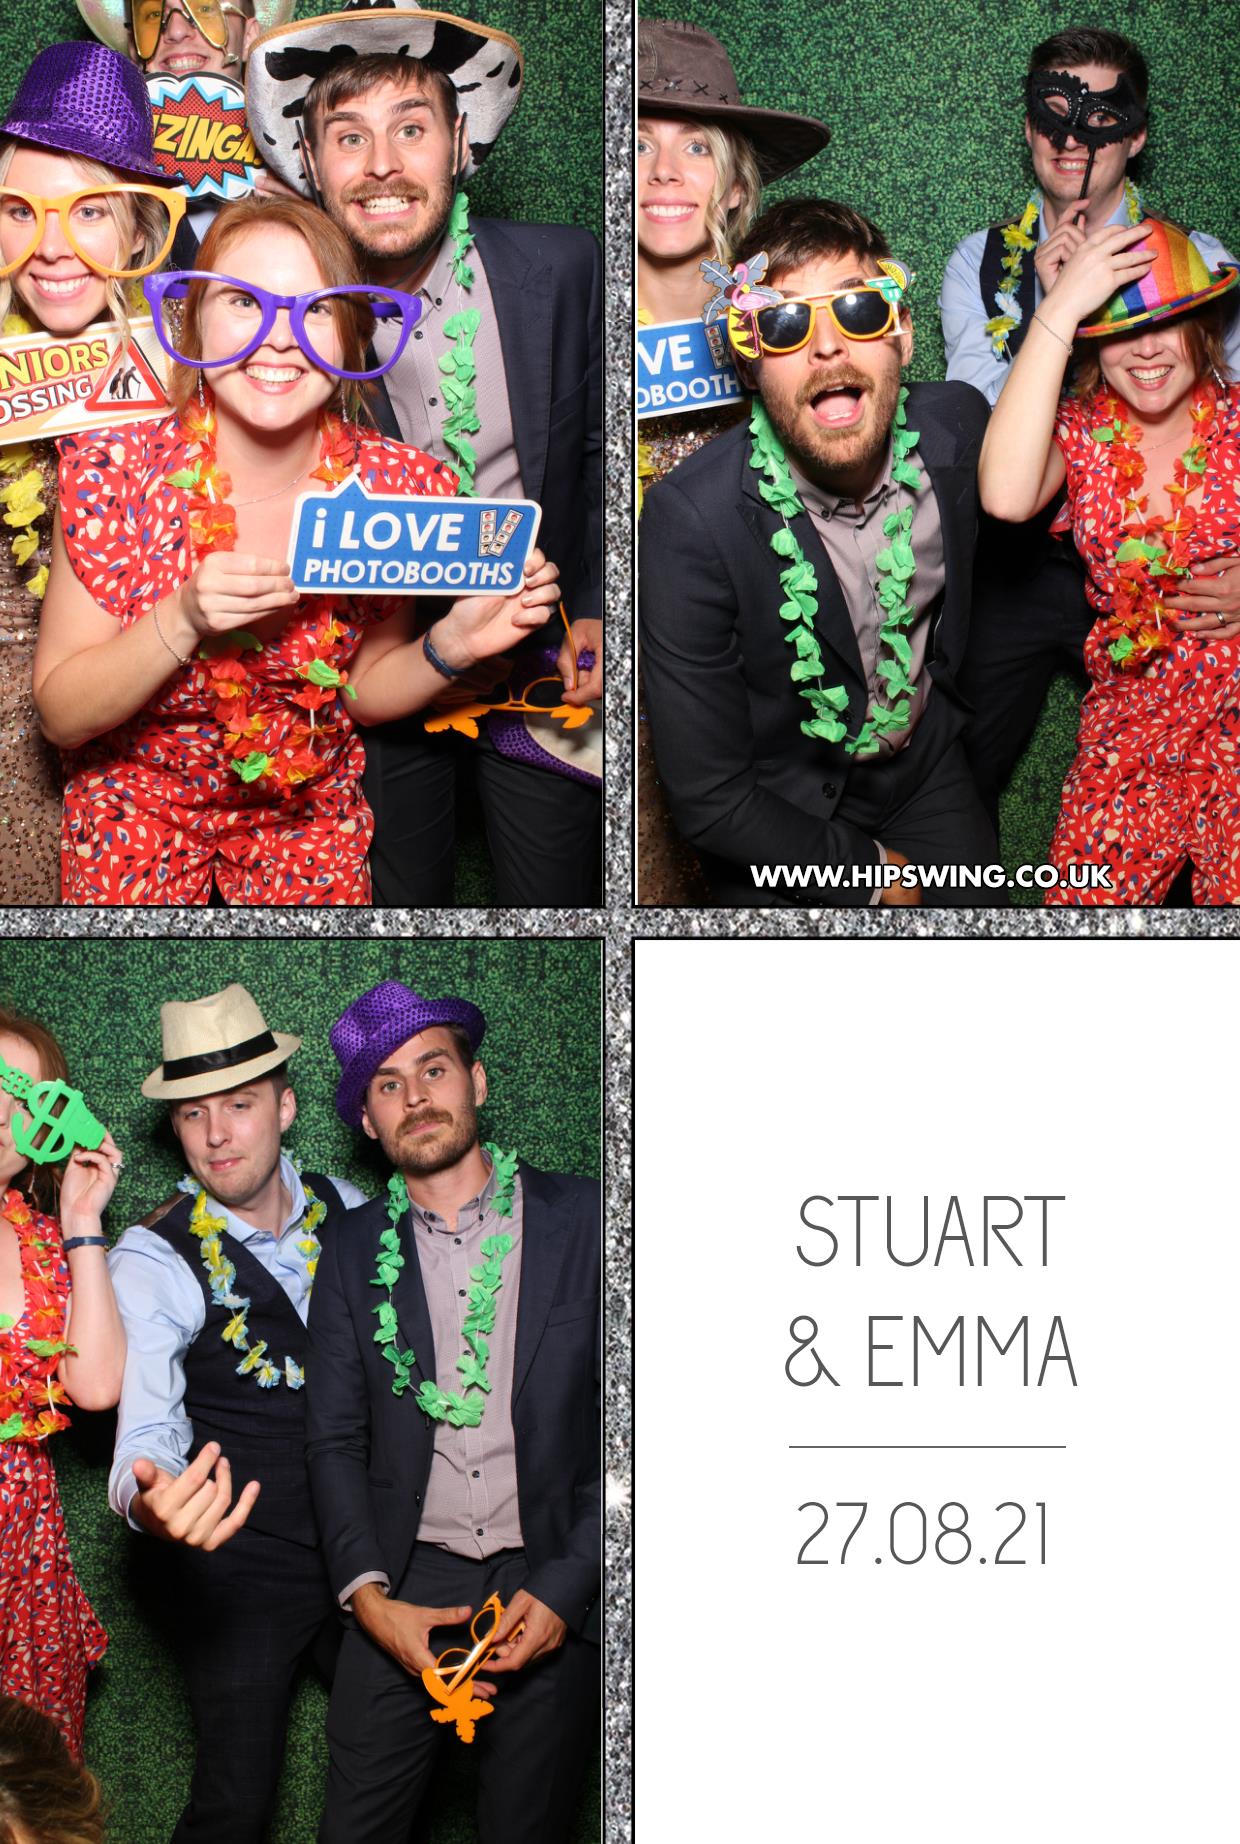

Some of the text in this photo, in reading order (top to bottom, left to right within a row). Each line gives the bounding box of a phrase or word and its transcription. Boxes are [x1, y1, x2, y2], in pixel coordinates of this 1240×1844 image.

[153, 114, 261, 165] ZINGA
[638, 334, 694, 375] VE
[312, 508, 464, 552] i LOVE
[303, 558, 515, 585] PHOTOBOOTHS
